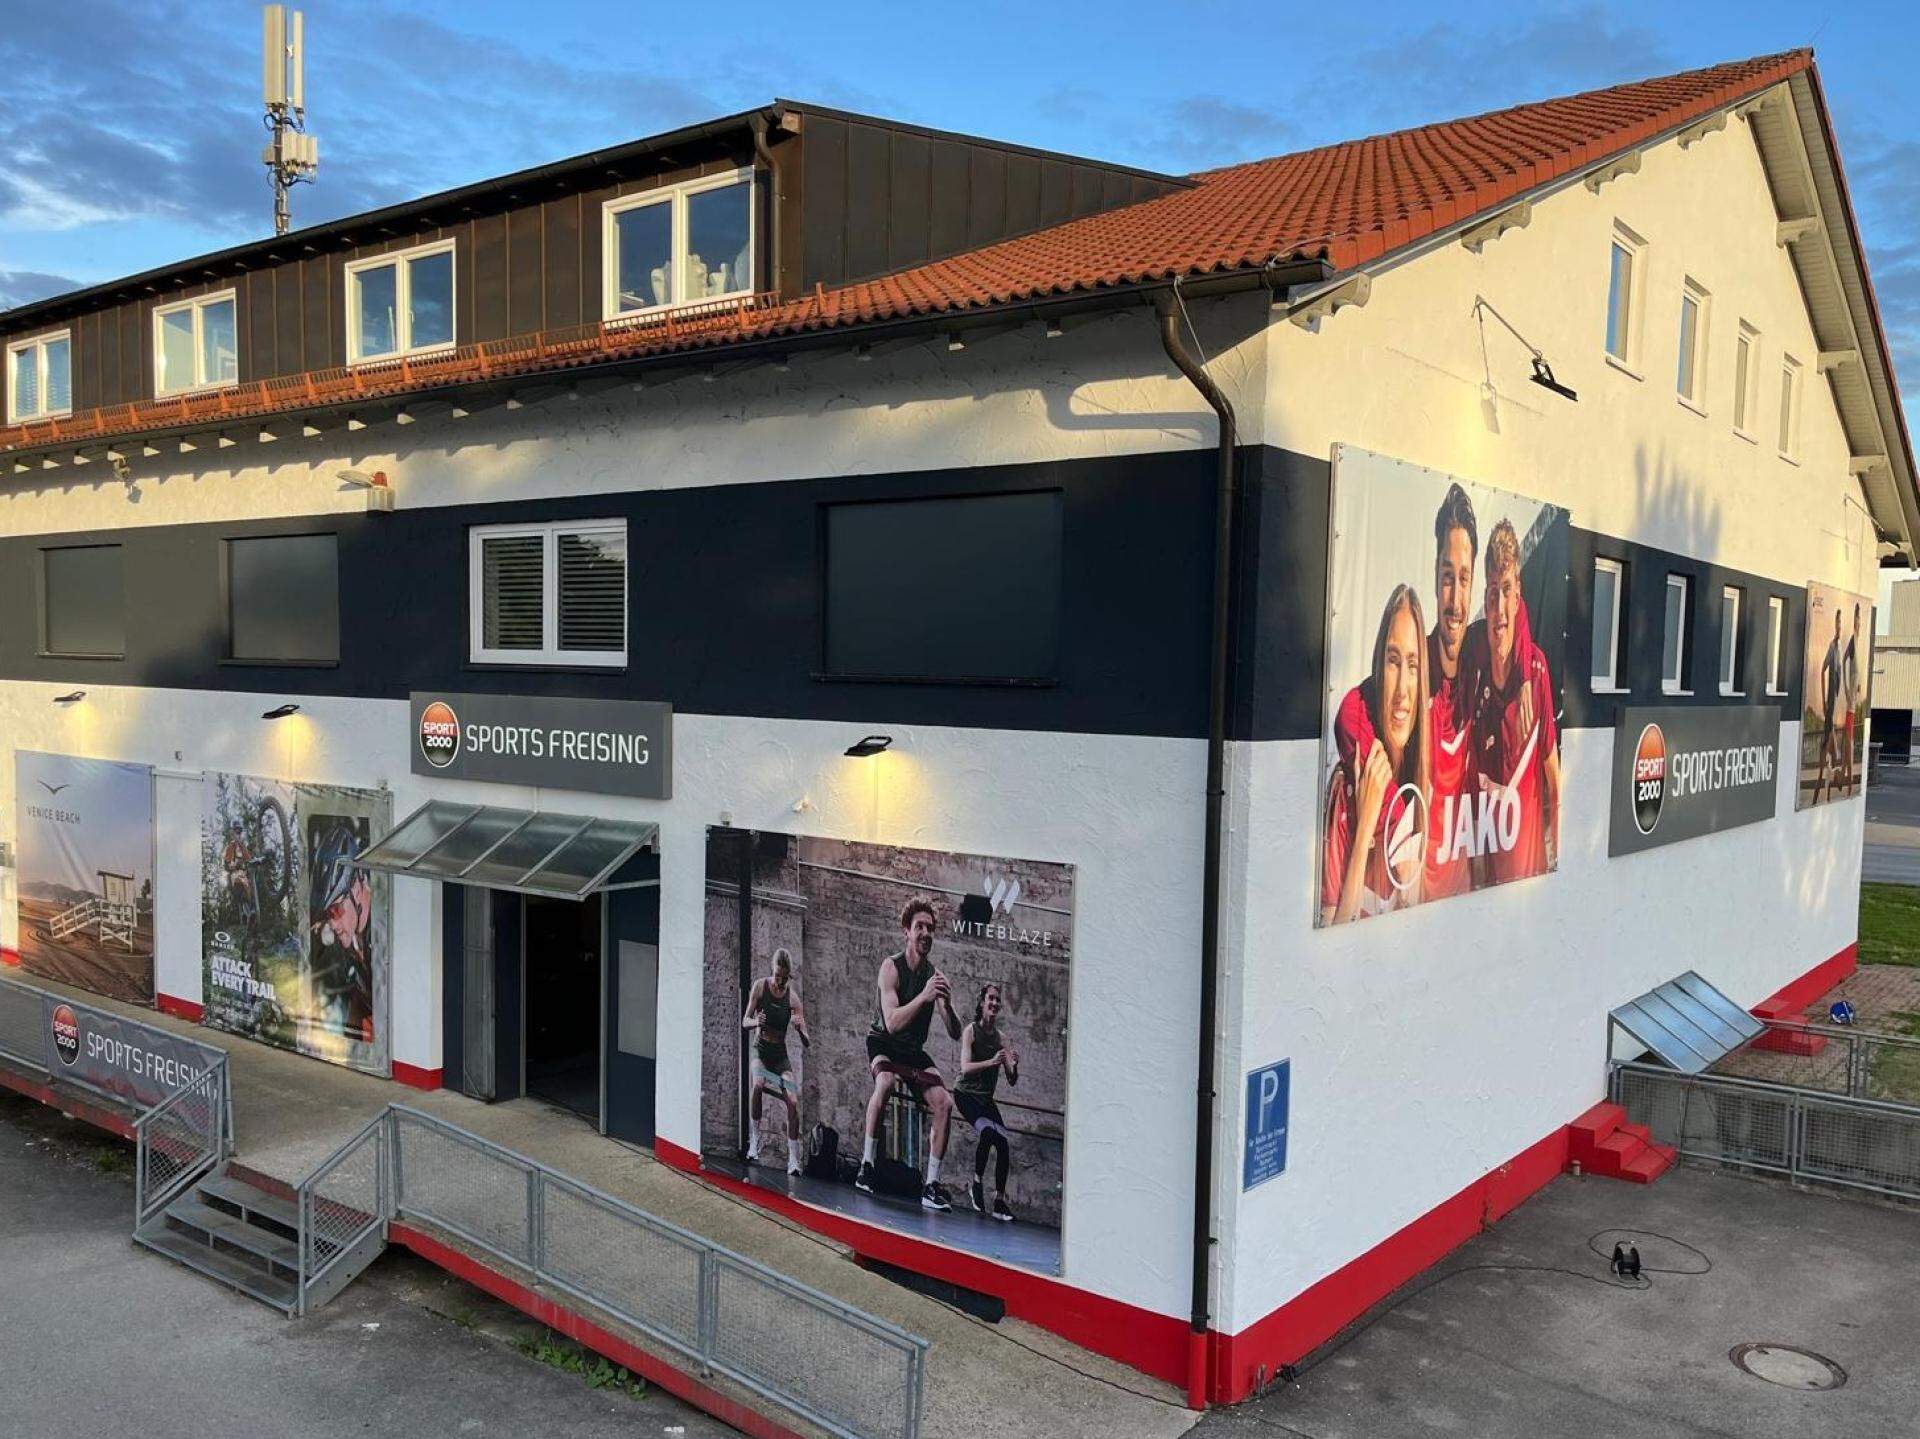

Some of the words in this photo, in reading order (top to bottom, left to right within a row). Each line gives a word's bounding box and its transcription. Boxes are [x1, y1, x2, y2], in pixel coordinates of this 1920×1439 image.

[423, 721, 455, 735] SPORT
[426, 735, 453, 749] 2000
[466, 724, 544, 757] SPORTS
[548, 729, 650, 765] FREISING
[1635, 756, 1665, 779] SPORT
[1671, 748, 1722, 797] SPORTS
[1724, 744, 1774, 789] FREISING
[1638, 781, 1661, 802] 2000
[27, 806, 54, 823] VENICE
[55, 809, 81, 825] BEACH
[1436, 784, 1521, 864] JAKO
[951, 919, 1052, 947] WITEBLAZE
[211, 955, 252, 978] ATTACK
[211, 969, 245, 992] EVERY
[246, 979, 277, 1001] TRAIL
[54, 1020, 78, 1038] SPORT
[57, 1034, 76, 1049] 2000
[86, 1031, 143, 1074] SPORTS
[1259, 1069, 1279, 1133] P
